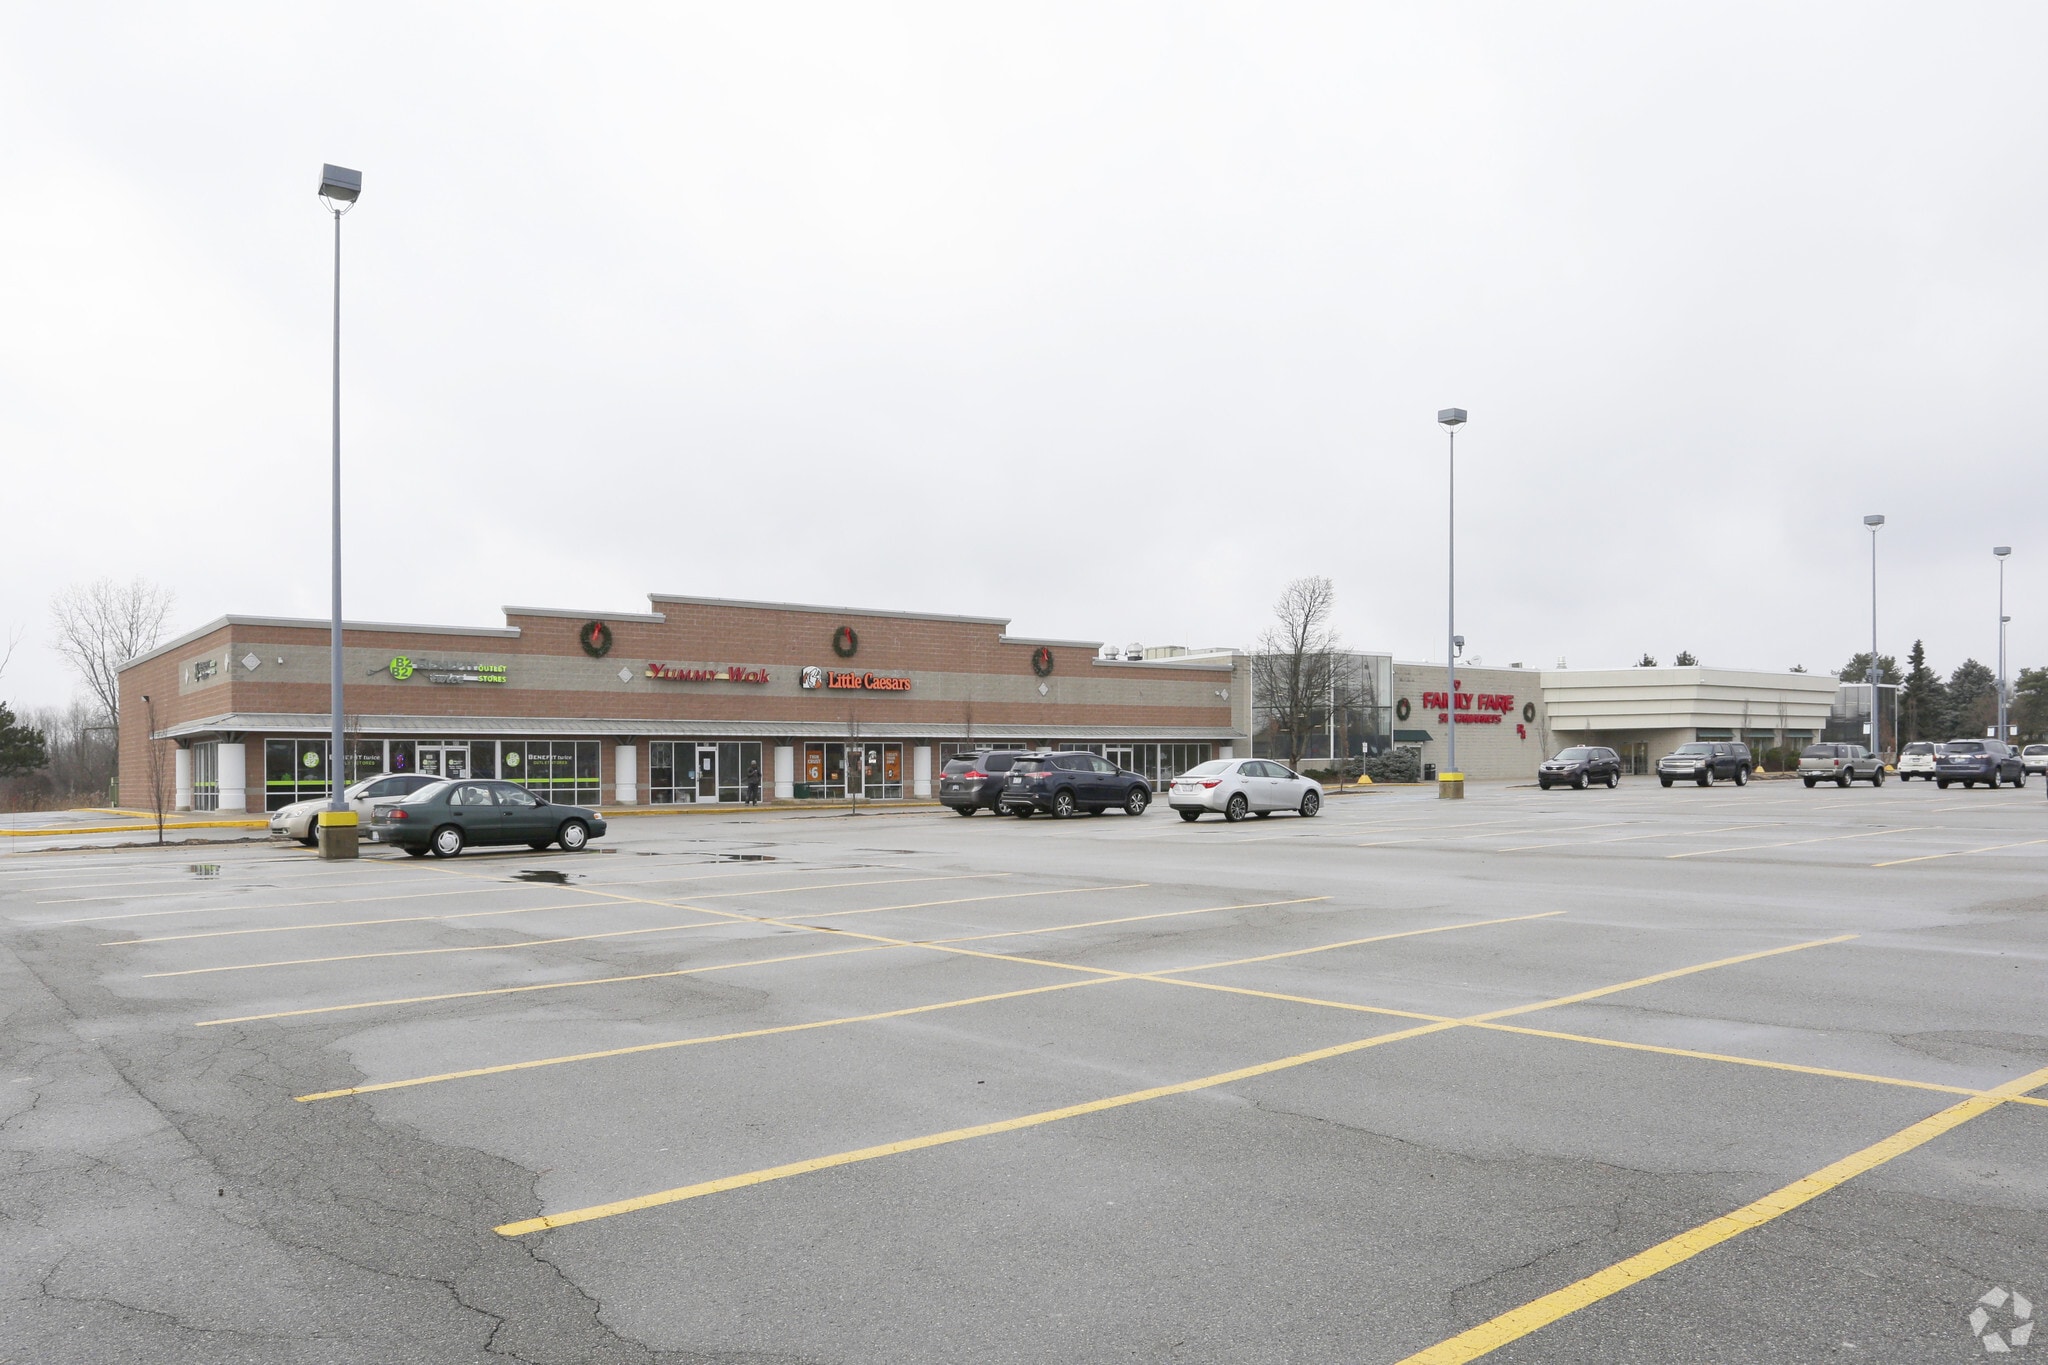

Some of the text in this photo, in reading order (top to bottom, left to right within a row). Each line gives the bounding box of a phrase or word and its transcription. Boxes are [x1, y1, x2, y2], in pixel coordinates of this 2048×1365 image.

[478, 665, 507, 673] OUTLET
[728, 666, 770, 682] Wok
[478, 675, 507, 683] STORES
[827, 671, 911, 691] Little Caesars
[1478, 693, 1514, 715] FARE
